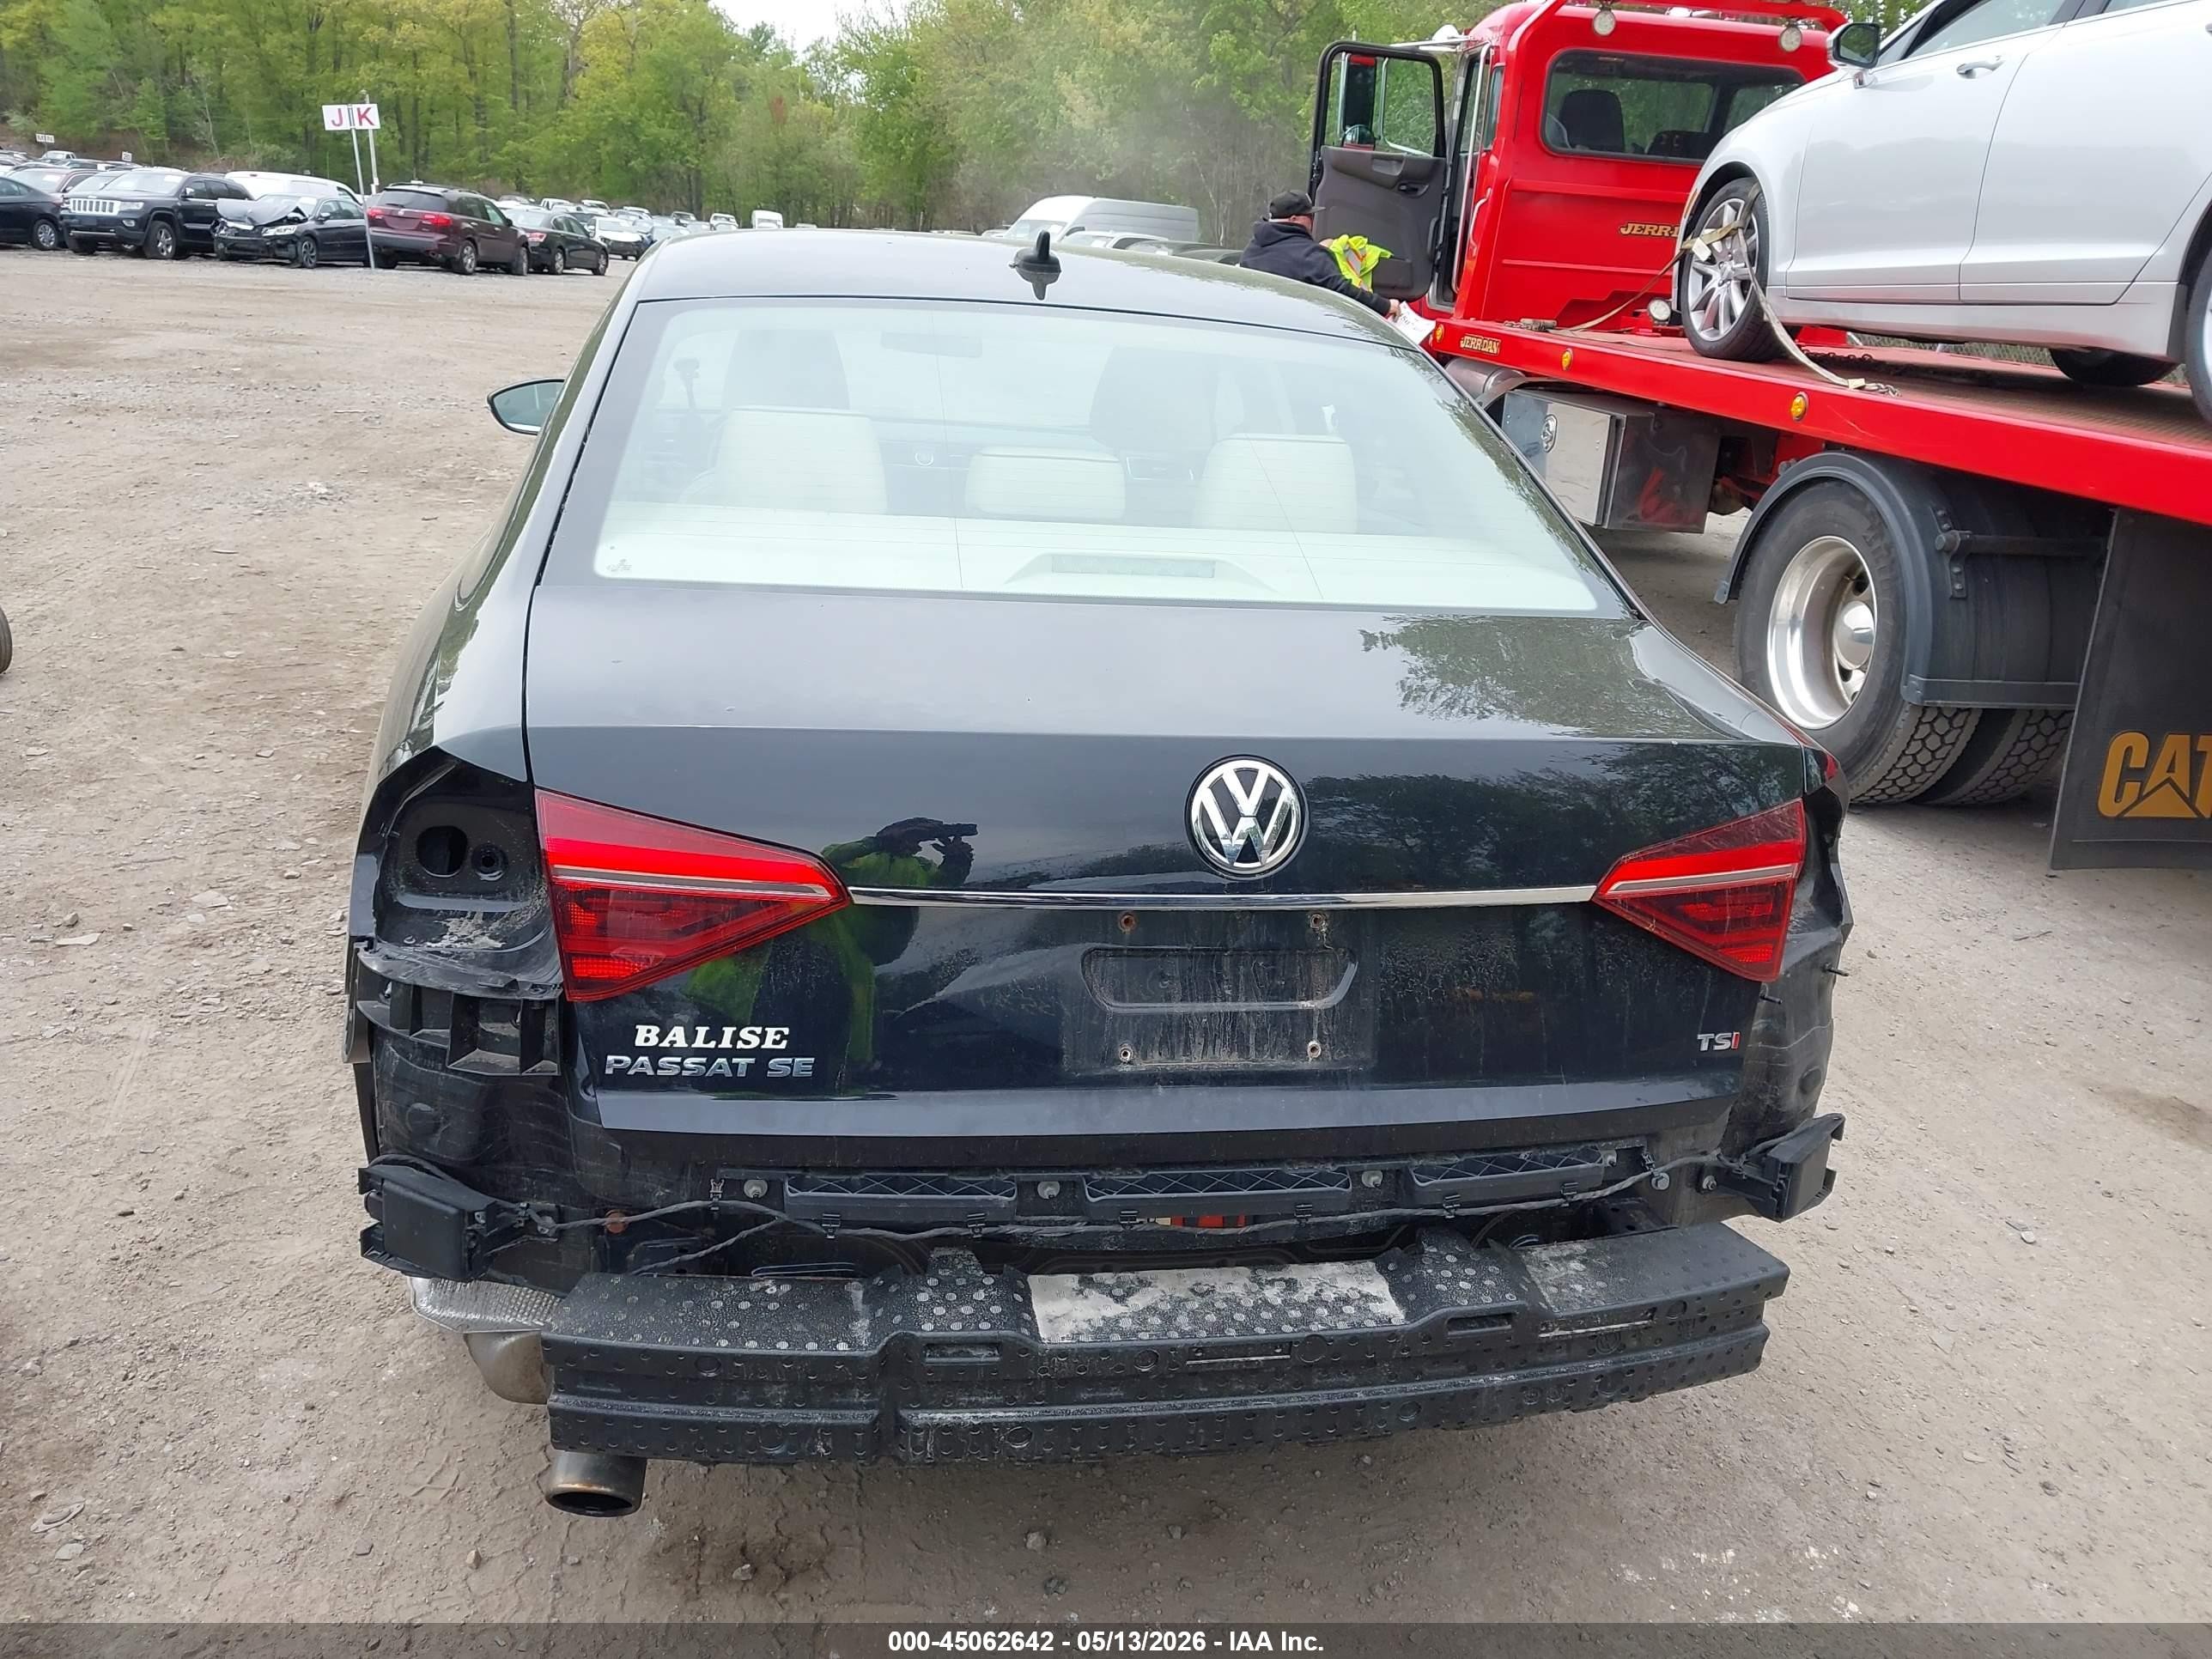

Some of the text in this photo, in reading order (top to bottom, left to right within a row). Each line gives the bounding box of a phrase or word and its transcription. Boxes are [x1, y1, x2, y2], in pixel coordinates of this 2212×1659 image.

[331, 106, 375, 127] J K
[635, 1024, 790, 1049] BALISE
[605, 1054, 815, 1078] PASSAT SE
